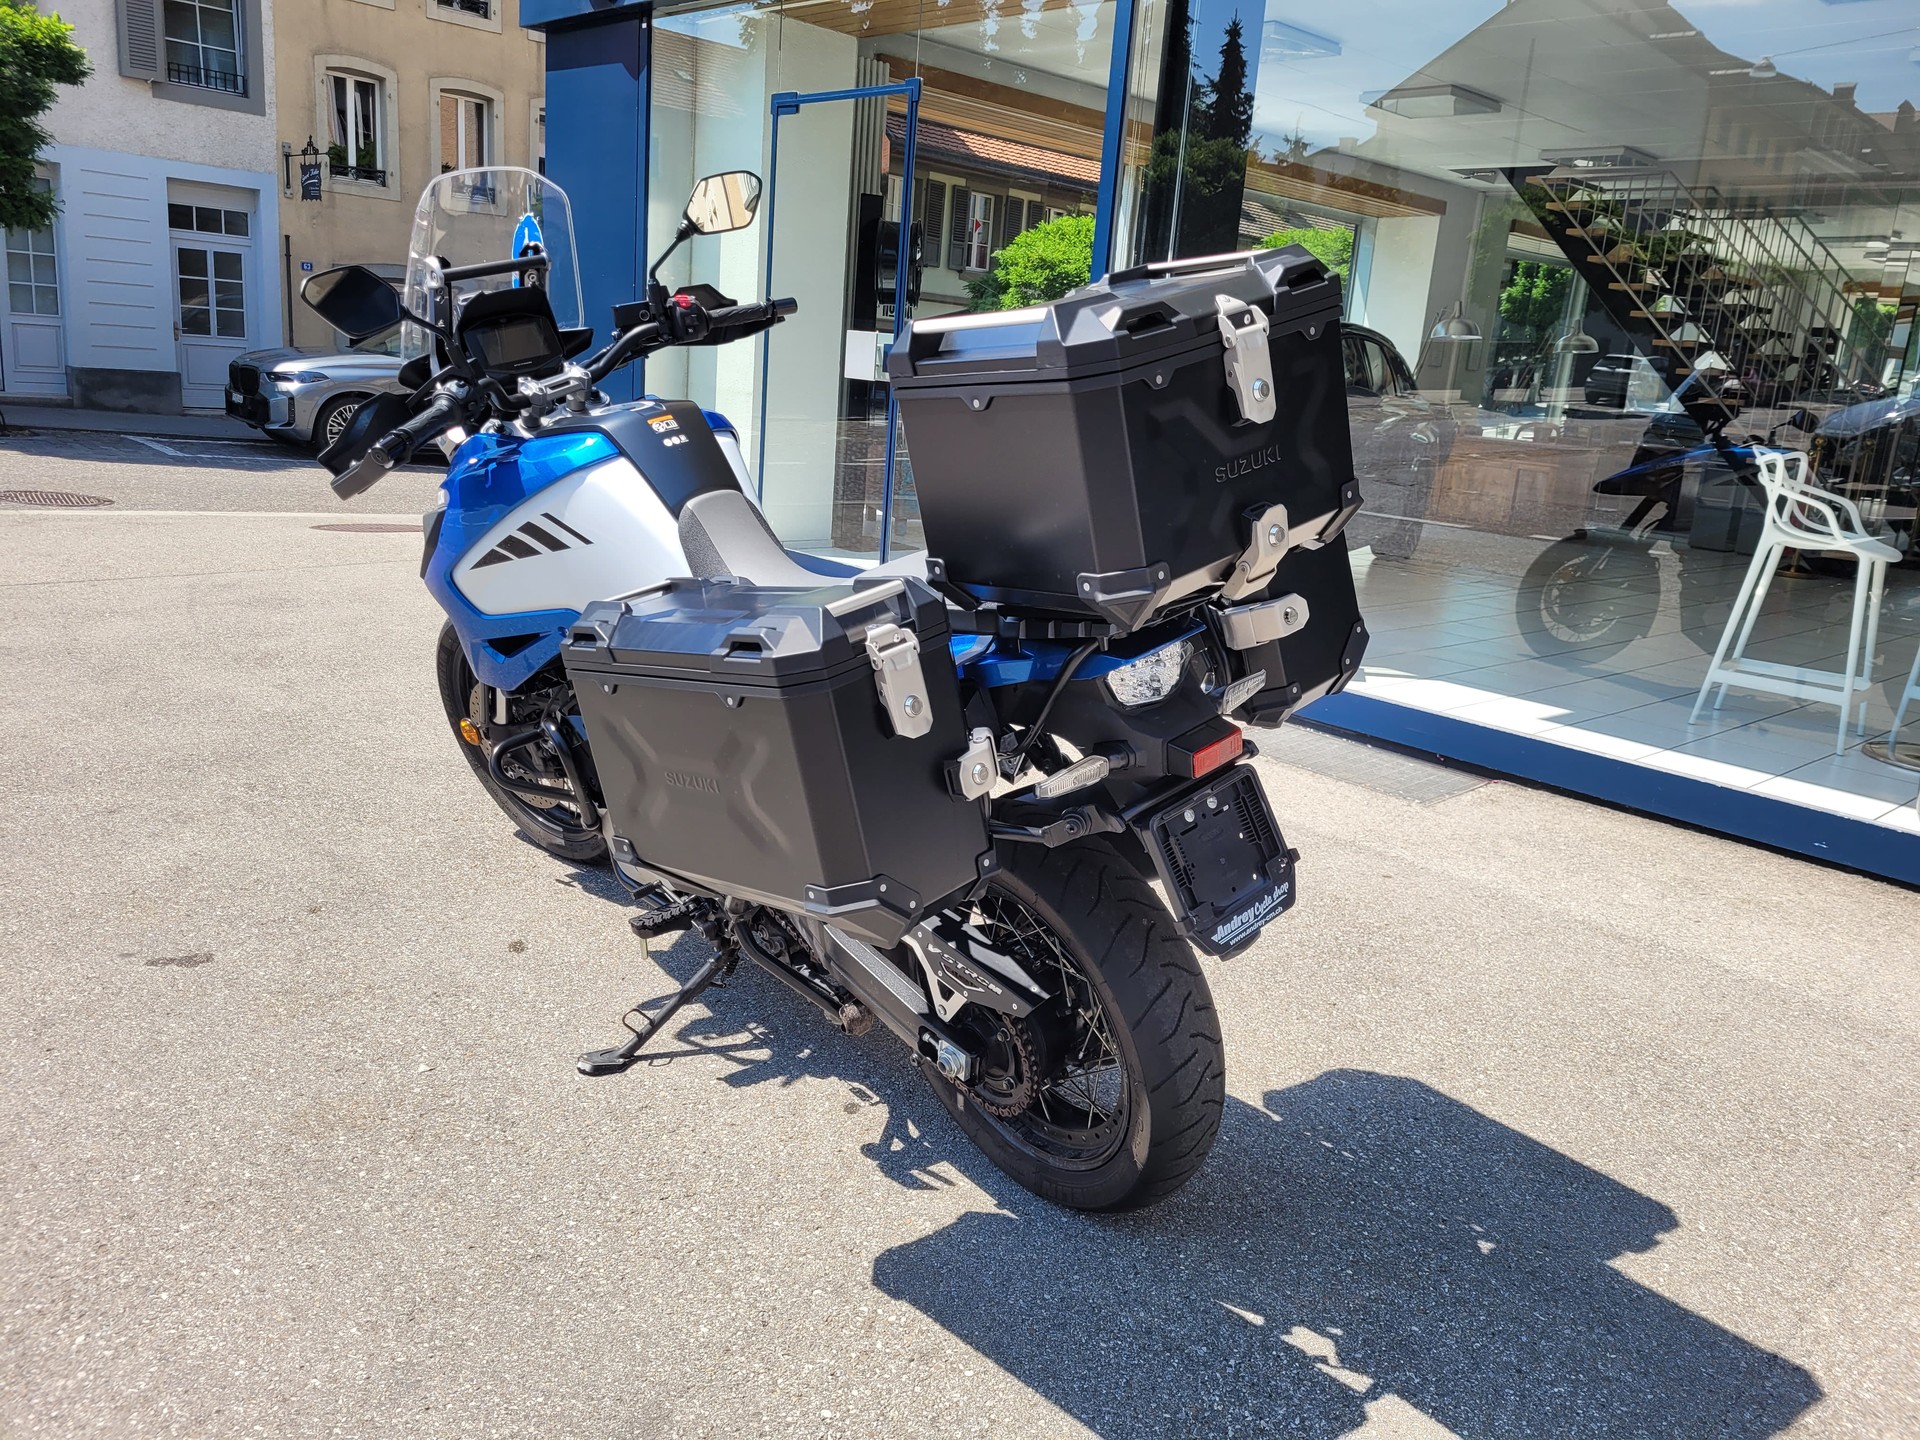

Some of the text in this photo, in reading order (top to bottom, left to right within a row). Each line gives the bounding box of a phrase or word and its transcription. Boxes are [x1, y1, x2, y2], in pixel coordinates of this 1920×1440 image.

[1215, 444, 1281, 483] SUZUKI
[664, 771, 720, 794] SUZUKI
[1216, 907, 1255, 940] Andrey
[1229, 906, 1283, 946] www.andrey-cm.ch
